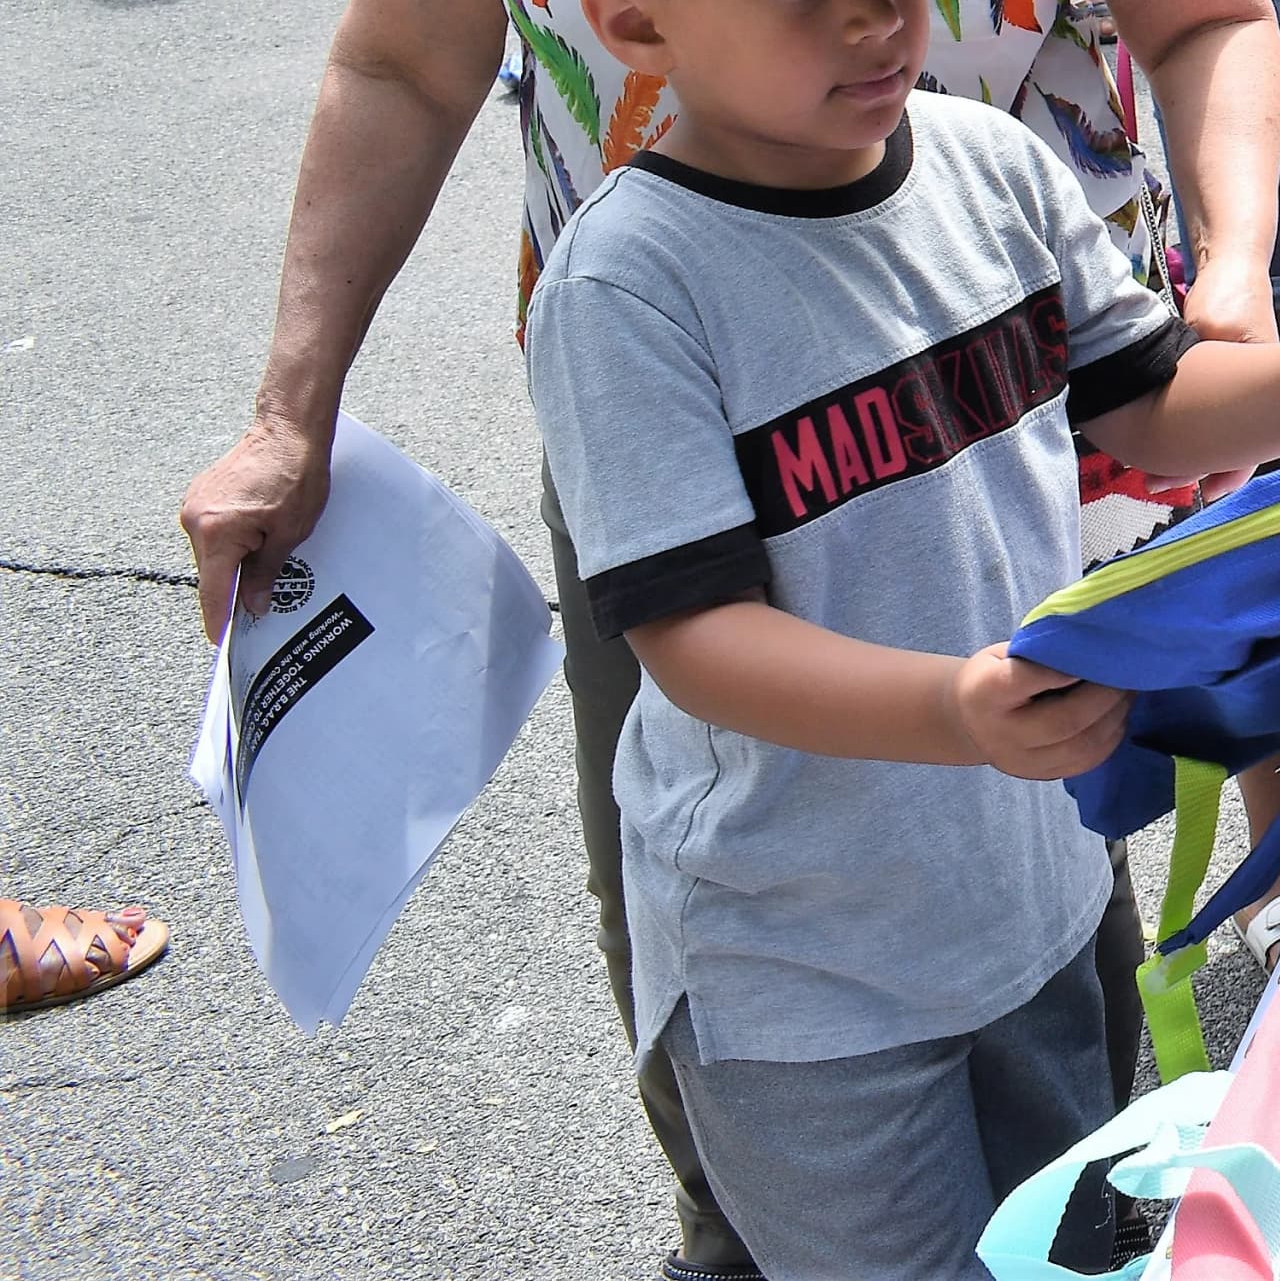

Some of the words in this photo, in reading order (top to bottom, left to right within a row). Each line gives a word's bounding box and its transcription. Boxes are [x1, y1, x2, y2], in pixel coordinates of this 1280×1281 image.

[291, 639, 309, 656] with
[302, 617, 352, 662] WORKING
[280, 654, 294, 666] the
[259, 661, 303, 707] TOGETHER
[285, 676, 307, 695] THE
[254, 708, 263, 721] TO
